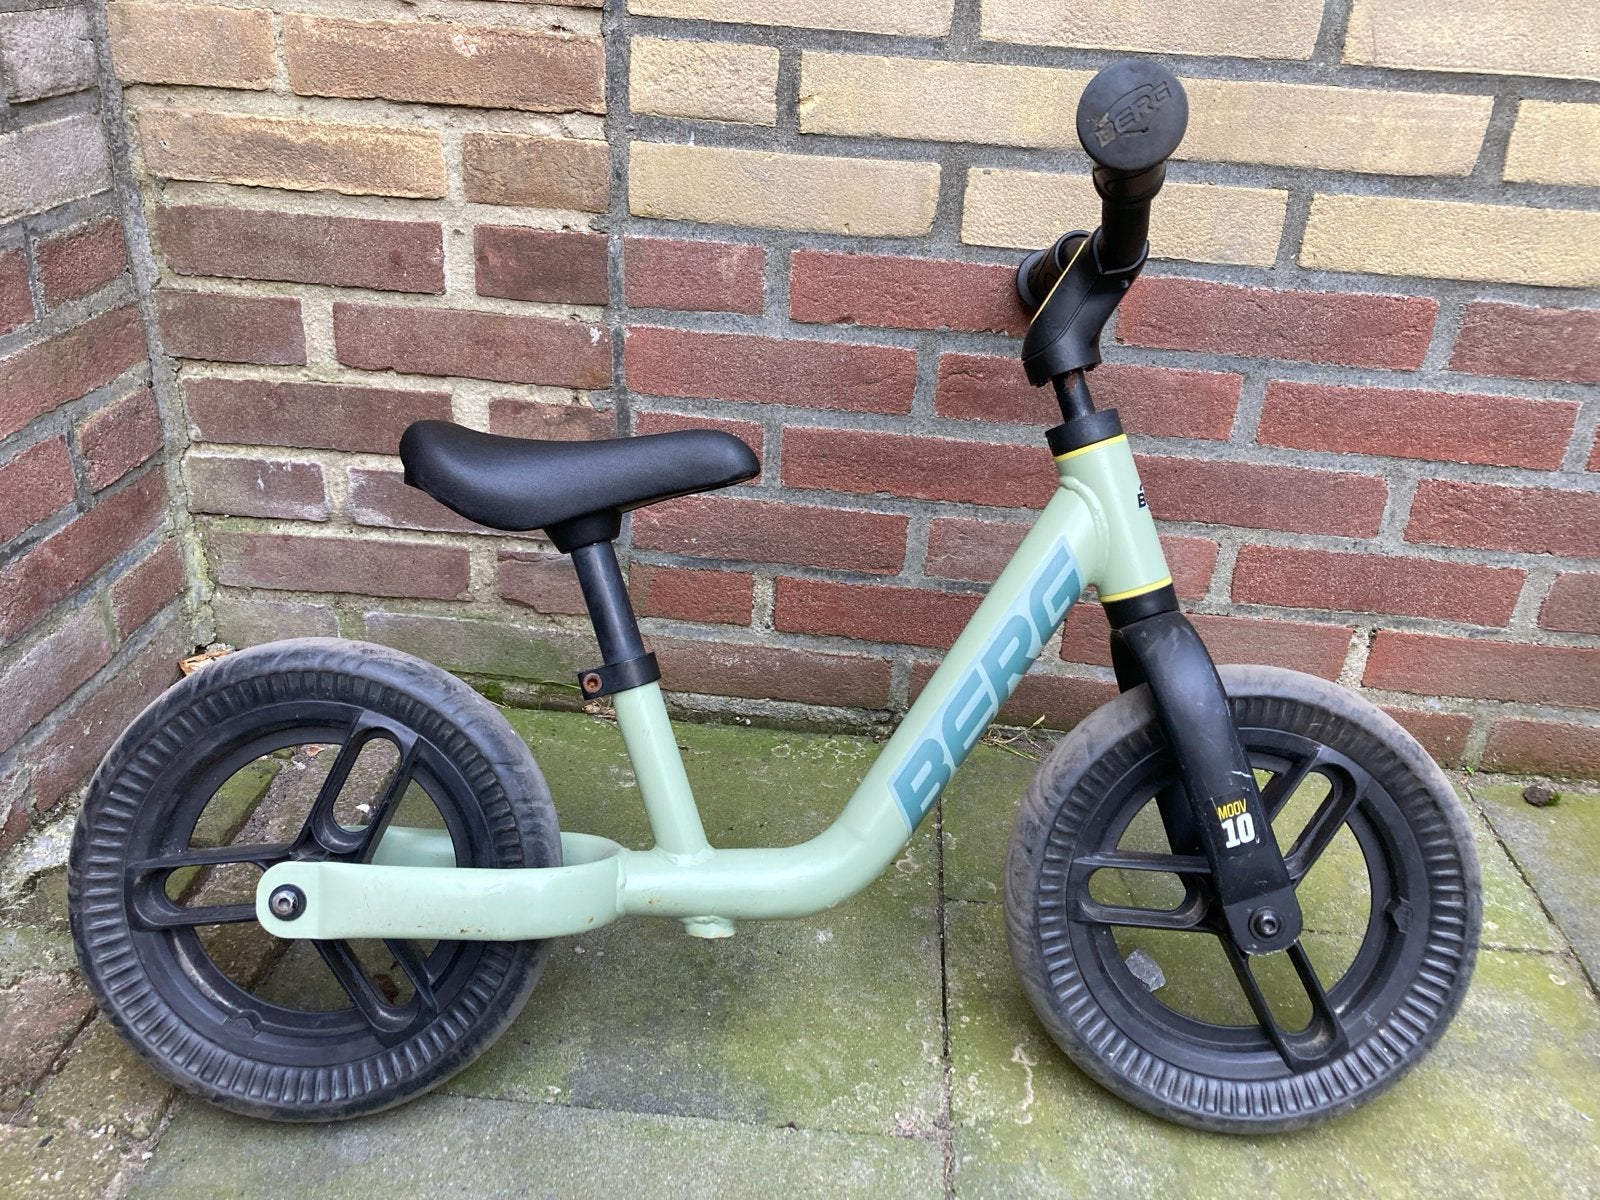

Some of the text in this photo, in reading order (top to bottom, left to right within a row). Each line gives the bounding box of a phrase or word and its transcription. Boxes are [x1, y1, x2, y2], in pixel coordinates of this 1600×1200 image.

[892, 545, 1081, 832] BERG
[1217, 798, 1247, 820] MOOV
[1221, 812, 1256, 849] 10
